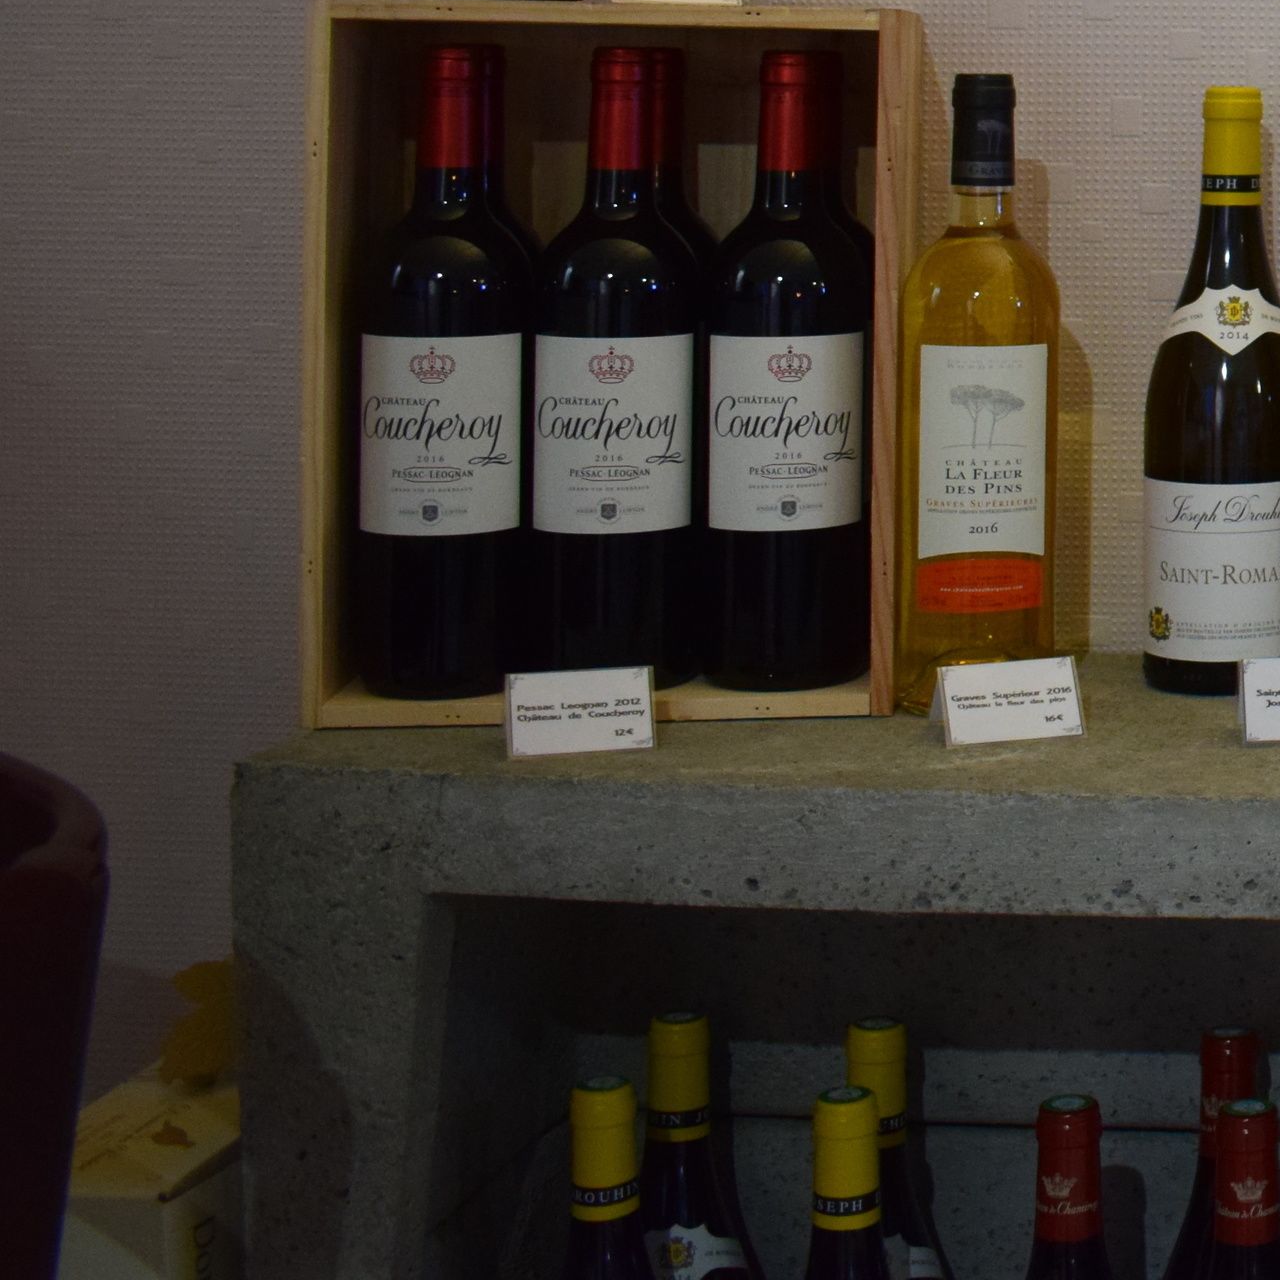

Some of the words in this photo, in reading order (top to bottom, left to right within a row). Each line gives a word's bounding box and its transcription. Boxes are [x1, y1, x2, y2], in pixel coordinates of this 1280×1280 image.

[1220, 332, 1250, 340] 2014
[364, 396, 513, 466] Coucheroy
[538, 396, 686, 466] Coucheroy
[715, 396, 857, 462] Coucheroy
[945, 468, 966, 480] LA
[973, 468, 1023, 480] FLEUR
[945, 485, 976, 494] DES
[984, 483, 1023, 494] PINS
[1166, 495, 1222, 530] Joseph
[969, 521, 999, 534] 2016
[1256, 689, 1280, 697] Saint
